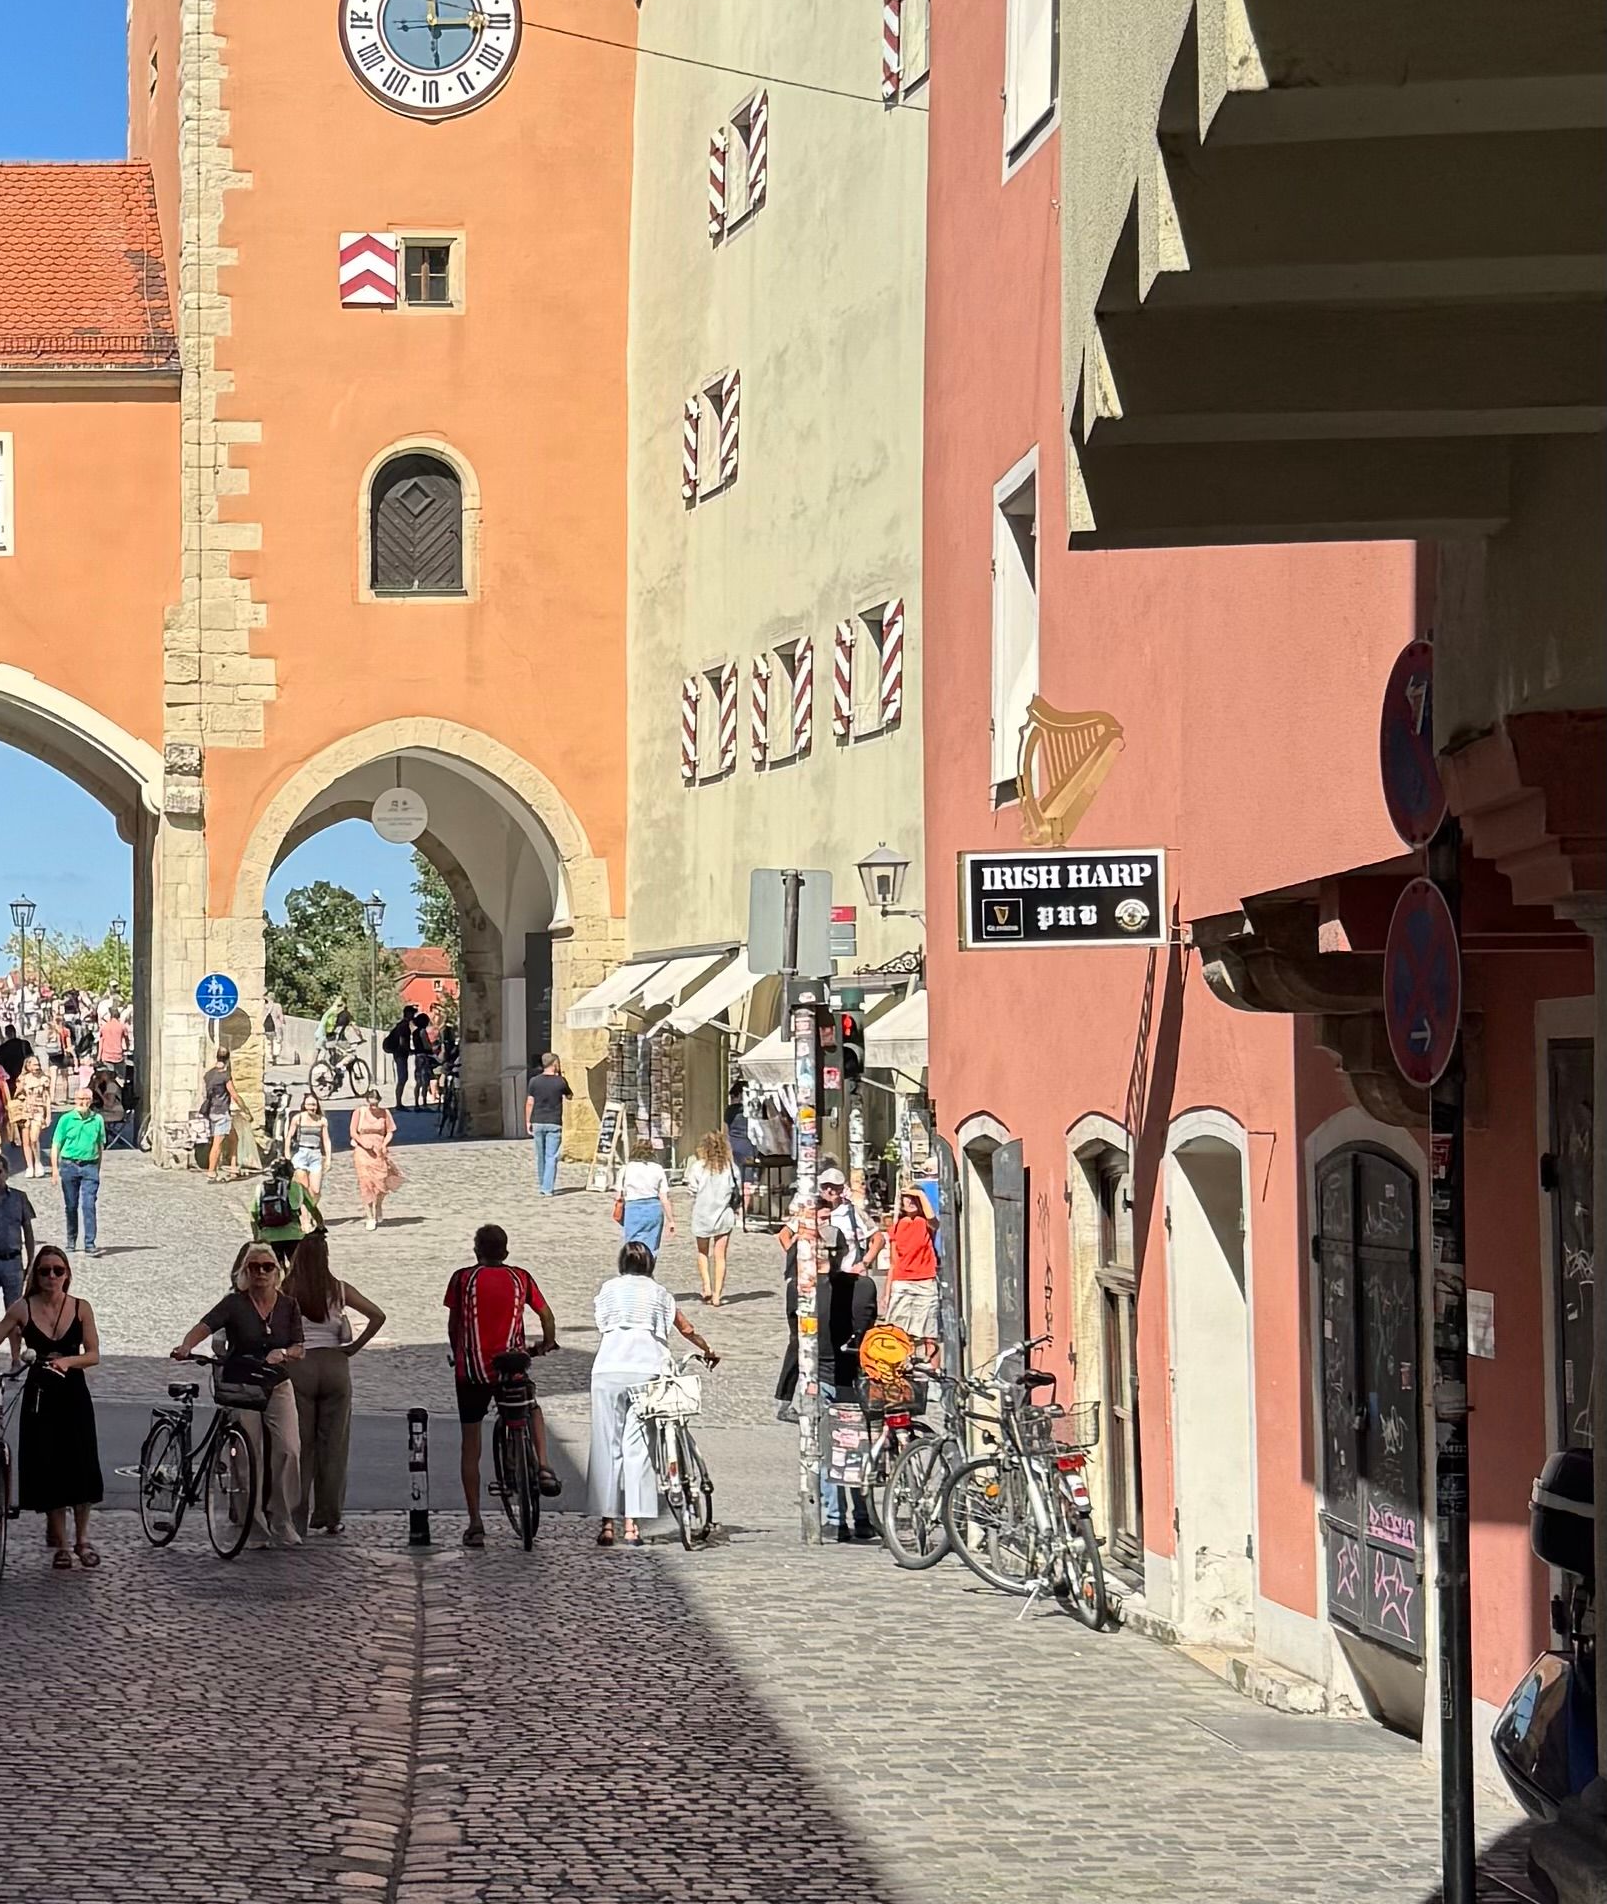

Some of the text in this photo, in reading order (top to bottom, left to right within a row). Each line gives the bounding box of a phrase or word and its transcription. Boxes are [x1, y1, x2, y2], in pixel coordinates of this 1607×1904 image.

[488, 13, 511, 30] III
[981, 863, 1152, 891] IRISH HARP
